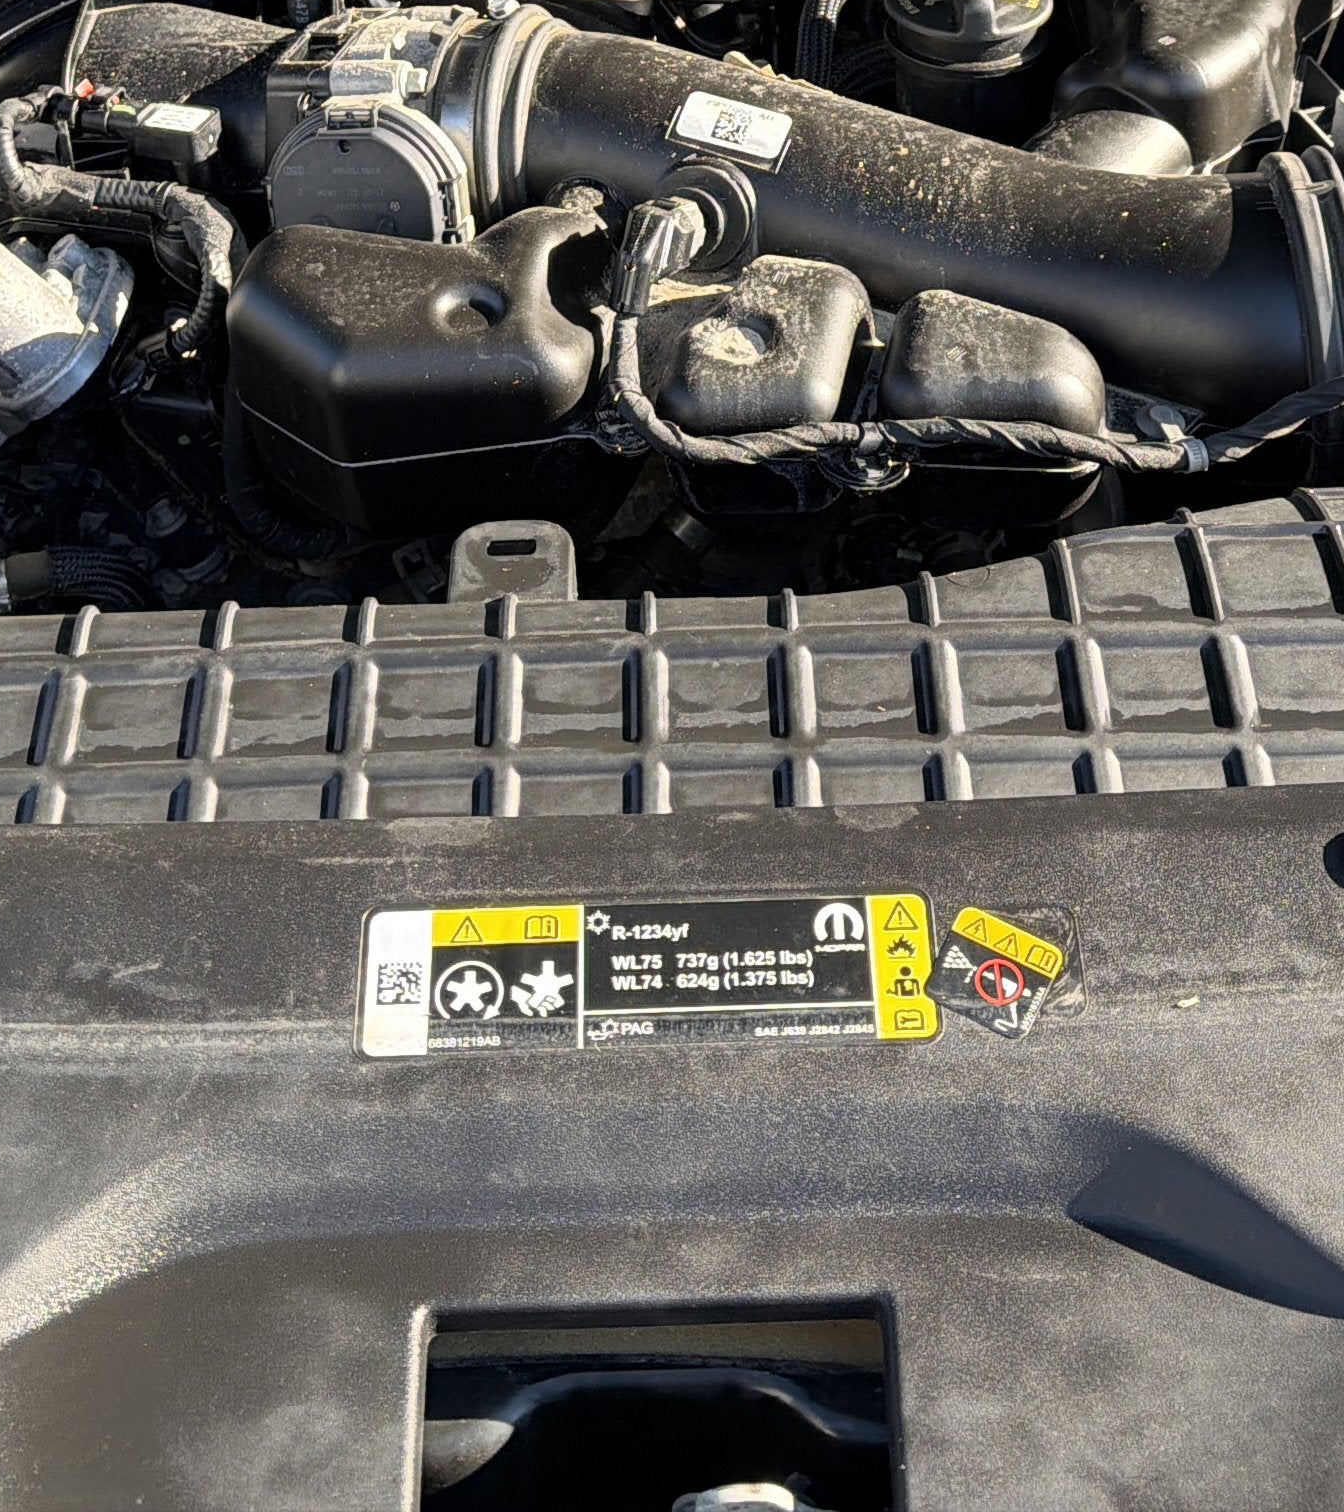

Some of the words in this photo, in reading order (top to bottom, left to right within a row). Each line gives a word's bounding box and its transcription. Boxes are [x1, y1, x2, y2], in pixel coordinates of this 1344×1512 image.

[611, 923, 689, 942] R-1234yf
[611, 954, 663, 971] WL75
[676, 953, 720, 971] 737g
[723, 950, 777, 971] (1.625
[780, 949, 813, 969] lbs)
[611, 974, 663, 991] WL74
[676, 973, 720, 991] 624g
[724, 971, 777, 991] (1.375
[780, 970, 815, 988] lbs)
[620, 1022, 654, 1036] PAG
[754, 1026, 779, 1037] SAE
[780, 1025, 807, 1037] J639
[428, 1034, 502, 1049] 68381219AB
